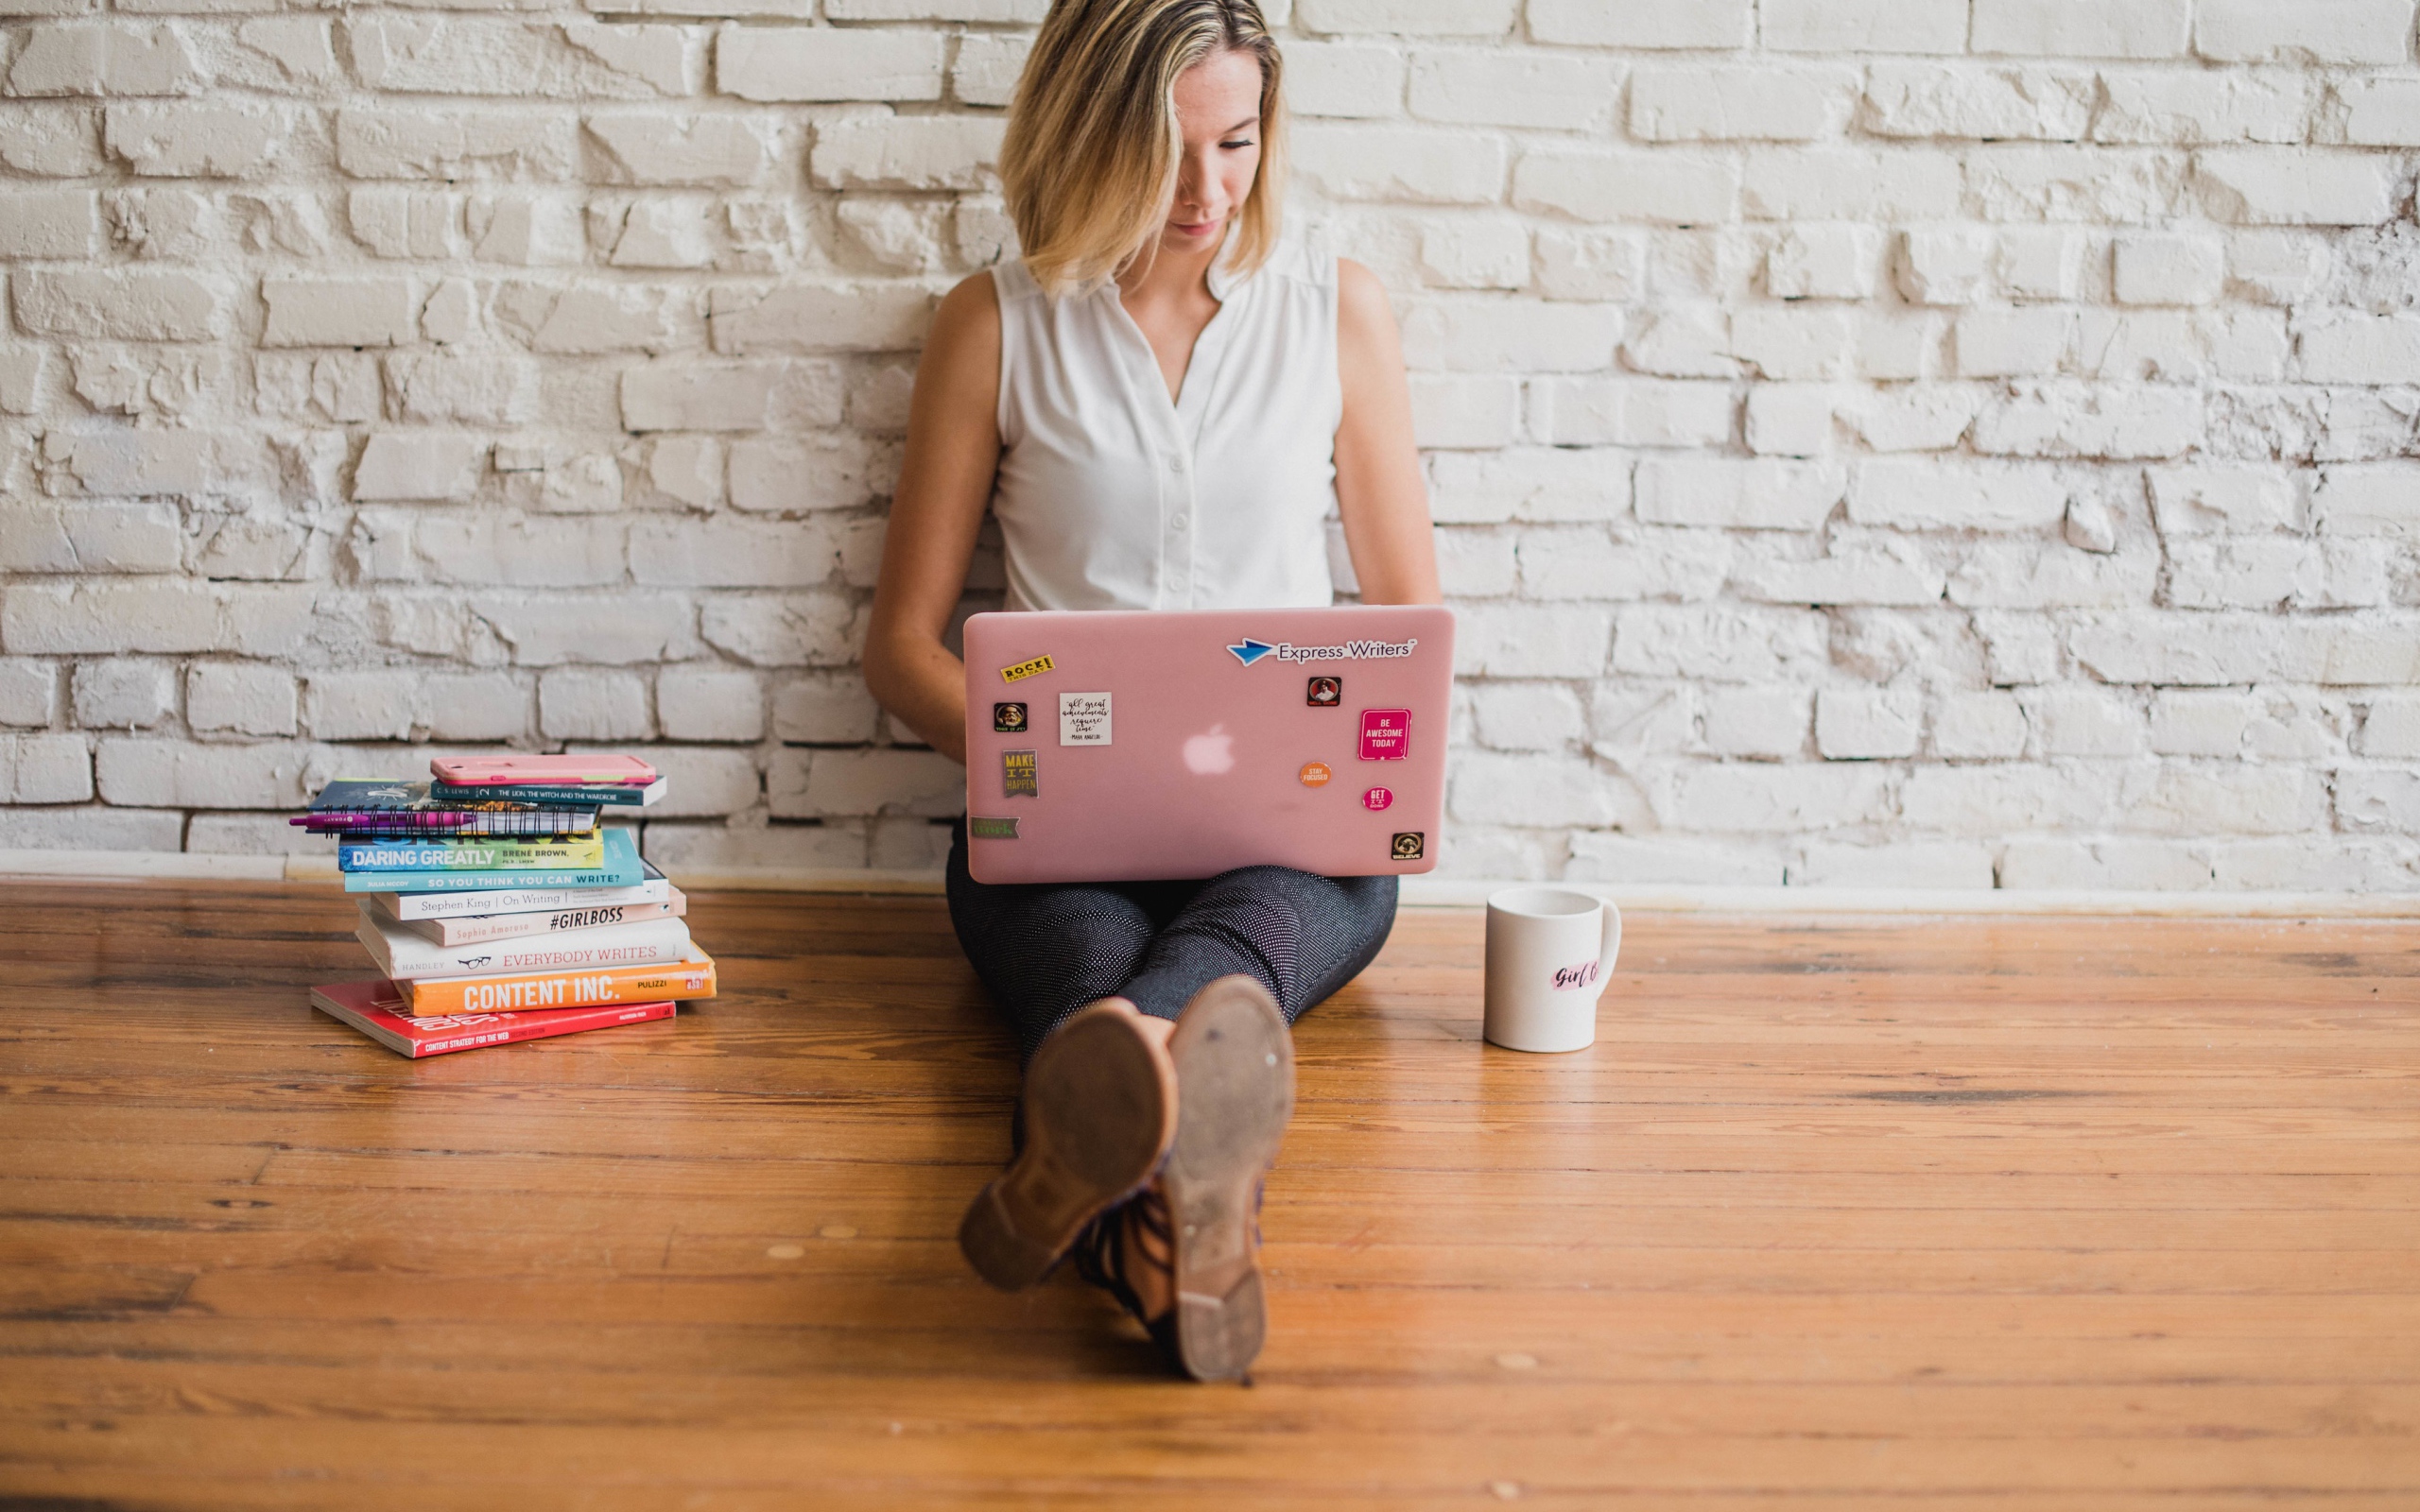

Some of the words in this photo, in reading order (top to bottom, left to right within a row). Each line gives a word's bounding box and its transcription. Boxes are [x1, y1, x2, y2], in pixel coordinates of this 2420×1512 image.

[1279, 644, 1343, 662] Express
[1005, 657, 1053, 678] ROCK!
[1008, 673, 1027, 681] THIS
[1028, 668, 1045, 677] DAY
[1085, 699, 1106, 711] great
[1070, 718, 1102, 727] require
[1380, 719, 1391, 728] BE
[1366, 729, 1403, 737] AWESOME
[1372, 739, 1396, 747] TODAY
[1006, 754, 1034, 767] MAKE
[1007, 768, 1035, 778] IT
[1304, 773, 1328, 782] FOCUSED
[1007, 779, 1036, 790] HAPPEN
[511, 789, 527, 798] LION,
[540, 790, 560, 799] WITCH
[586, 793, 617, 801] WARDROBE
[1370, 789, 1385, 799] GET
[353, 850, 417, 867] DARING
[421, 850, 495, 866] GREATLY
[502, 848, 532, 857] BRENÉ
[535, 850, 569, 858] BROWN,
[427, 878, 444, 887] SO
[448, 878, 473, 887] YOU
[476, 877, 514, 886] THINK
[518, 876, 544, 885] YOU
[546, 875, 572, 885] CAN
[577, 874, 620, 884] WRITE?
[422, 901, 463, 912] Stephen
[467, 898, 491, 909] King
[503, 896, 519, 905] On
[522, 895, 561, 904] Writing
[550, 906, 624, 931] #GIRLBOSS
[457, 928, 487, 939] Sophia
[491, 923, 529, 935] Amoruso
[503, 950, 593, 967] EVERYBODY
[596, 946, 657, 960] WRITES
[402, 962, 445, 971] HANDLEY
[1555, 963, 1589, 988] Girl
[637, 980, 667, 988] PULIZZI
[464, 979, 567, 1011] CONTENT
[574, 975, 620, 1003] INC.
[424, 1041, 449, 1053] CONTENT
[449, 1038, 475, 1049] STRATEGY
[475, 1035, 487, 1044] FOR
[487, 1034, 497, 1042] THE
[497, 1032, 510, 1040] WEB
